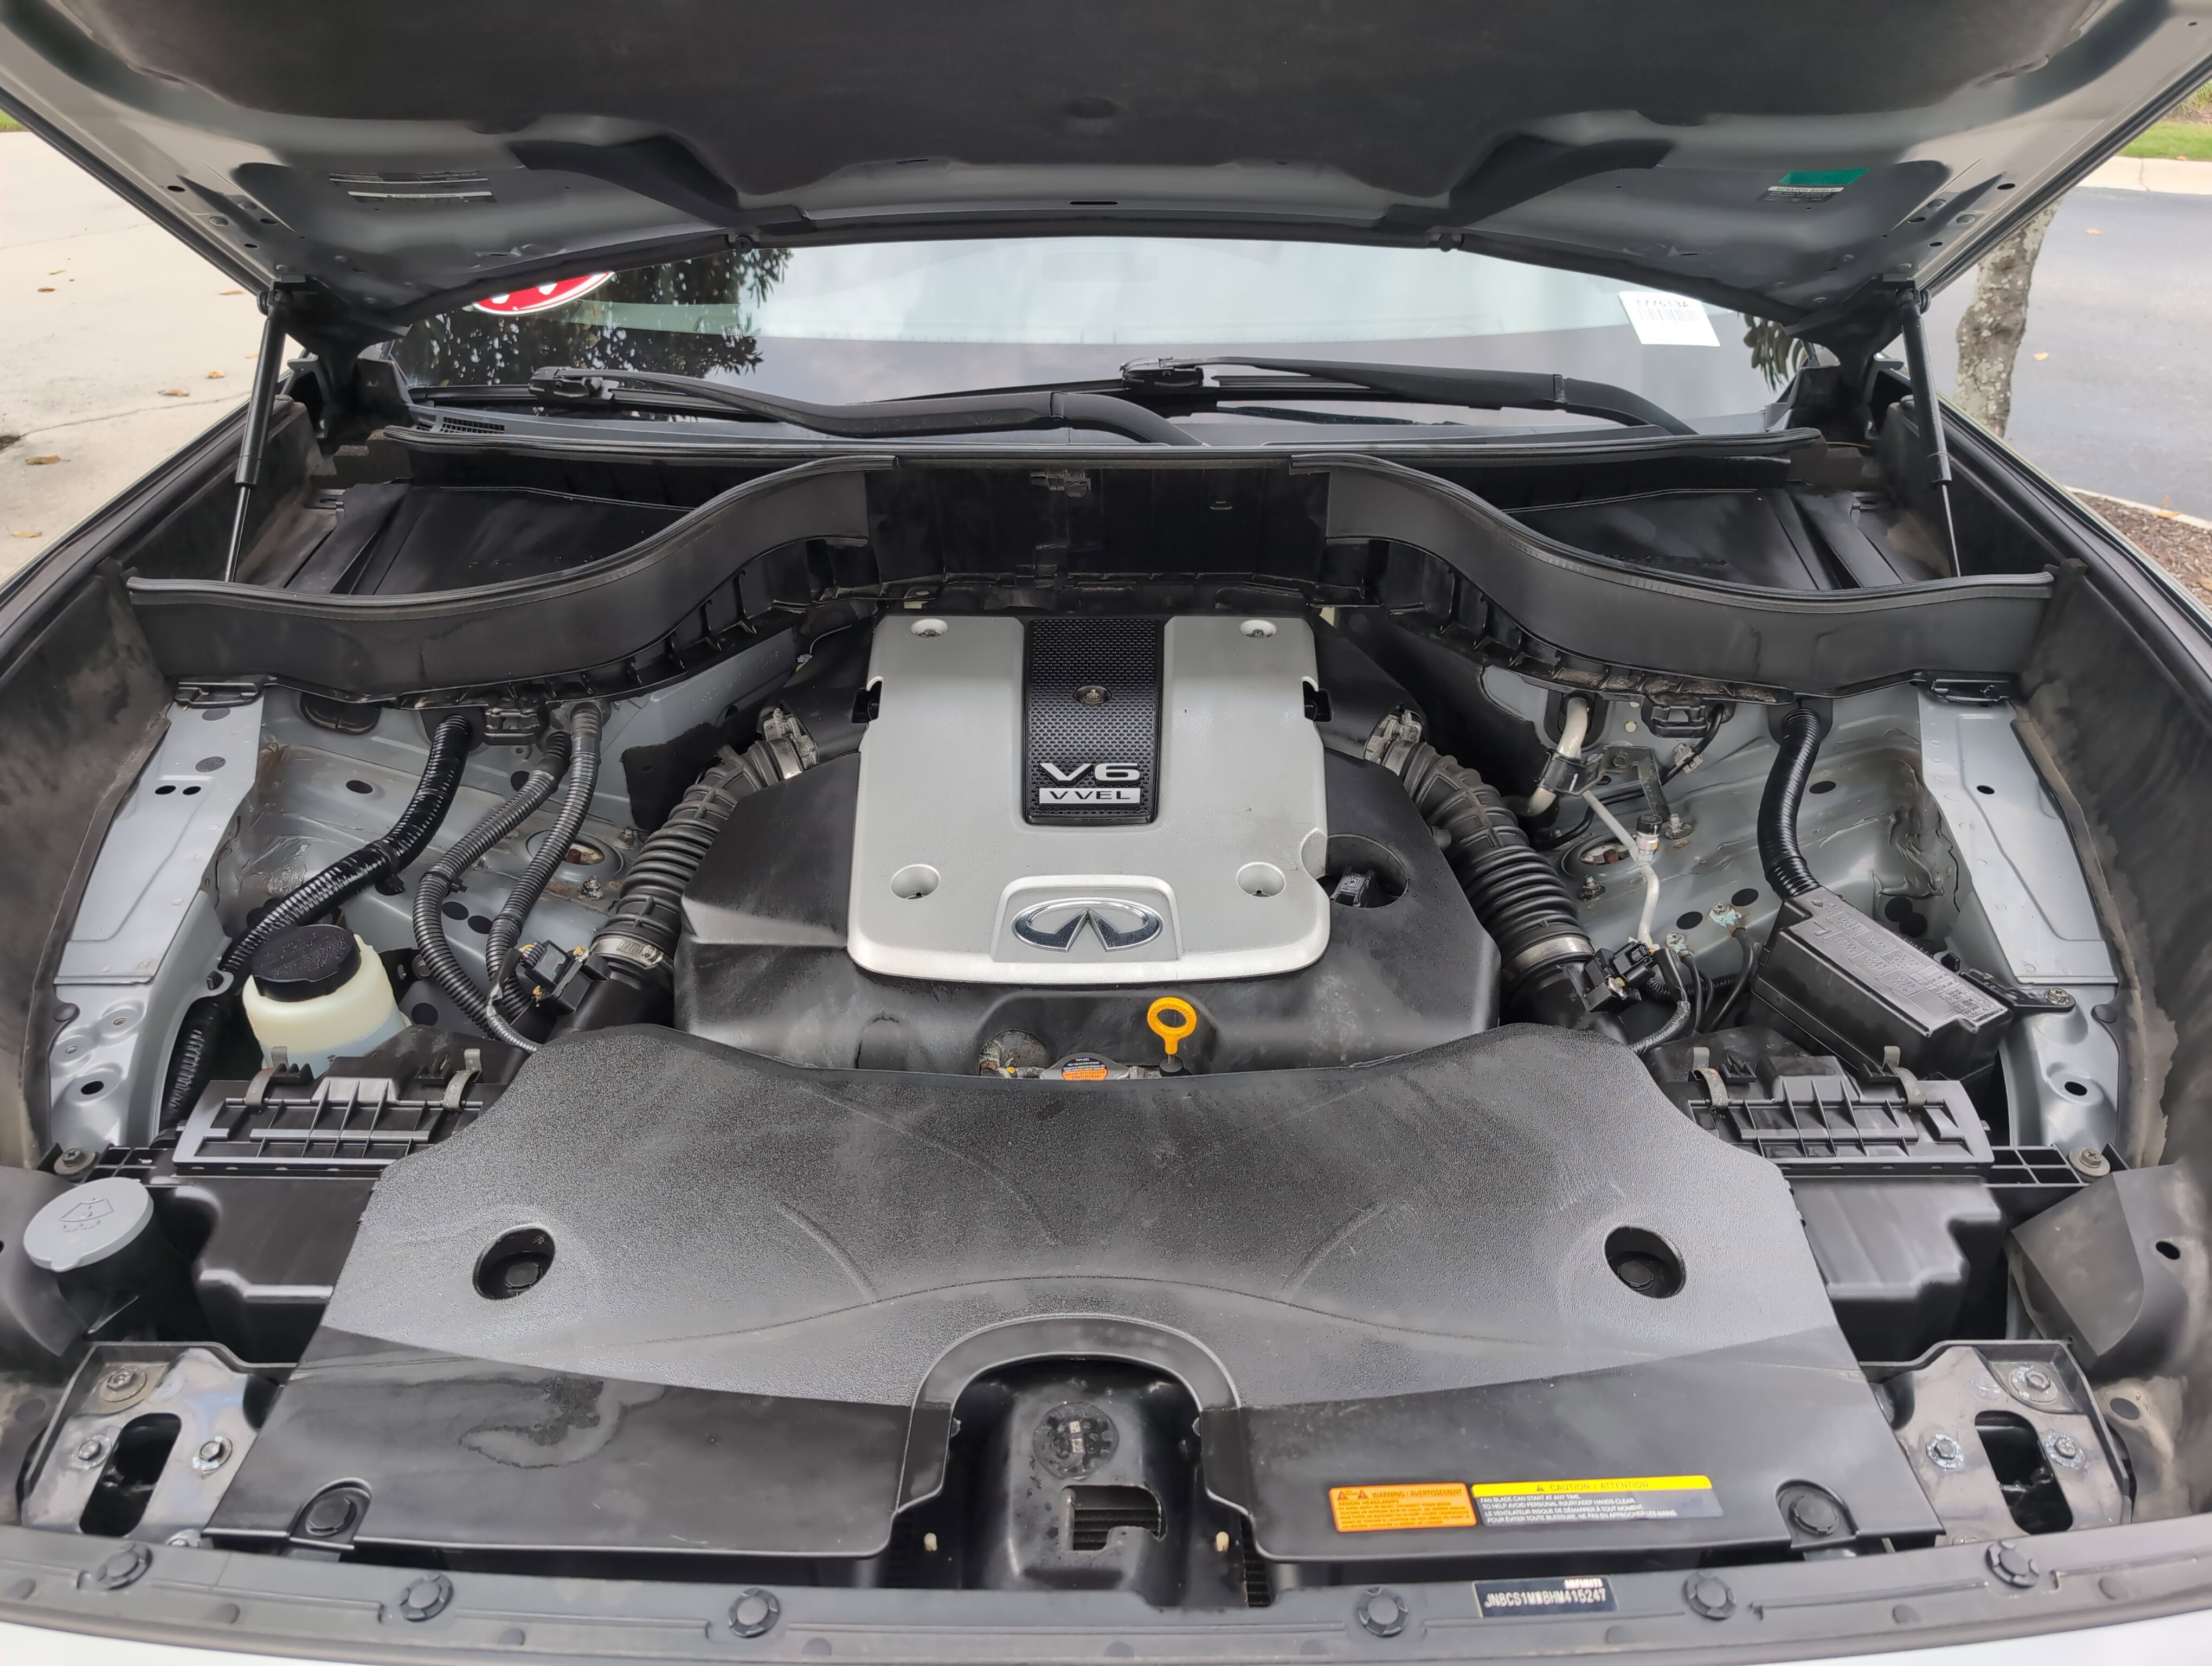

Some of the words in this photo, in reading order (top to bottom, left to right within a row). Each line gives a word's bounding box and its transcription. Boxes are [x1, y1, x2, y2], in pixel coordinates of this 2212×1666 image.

[1040, 763, 1140, 783] V6
[1049, 790, 1131, 800] VVEL
[1150, 1003, 1174, 1018] ENGINE
